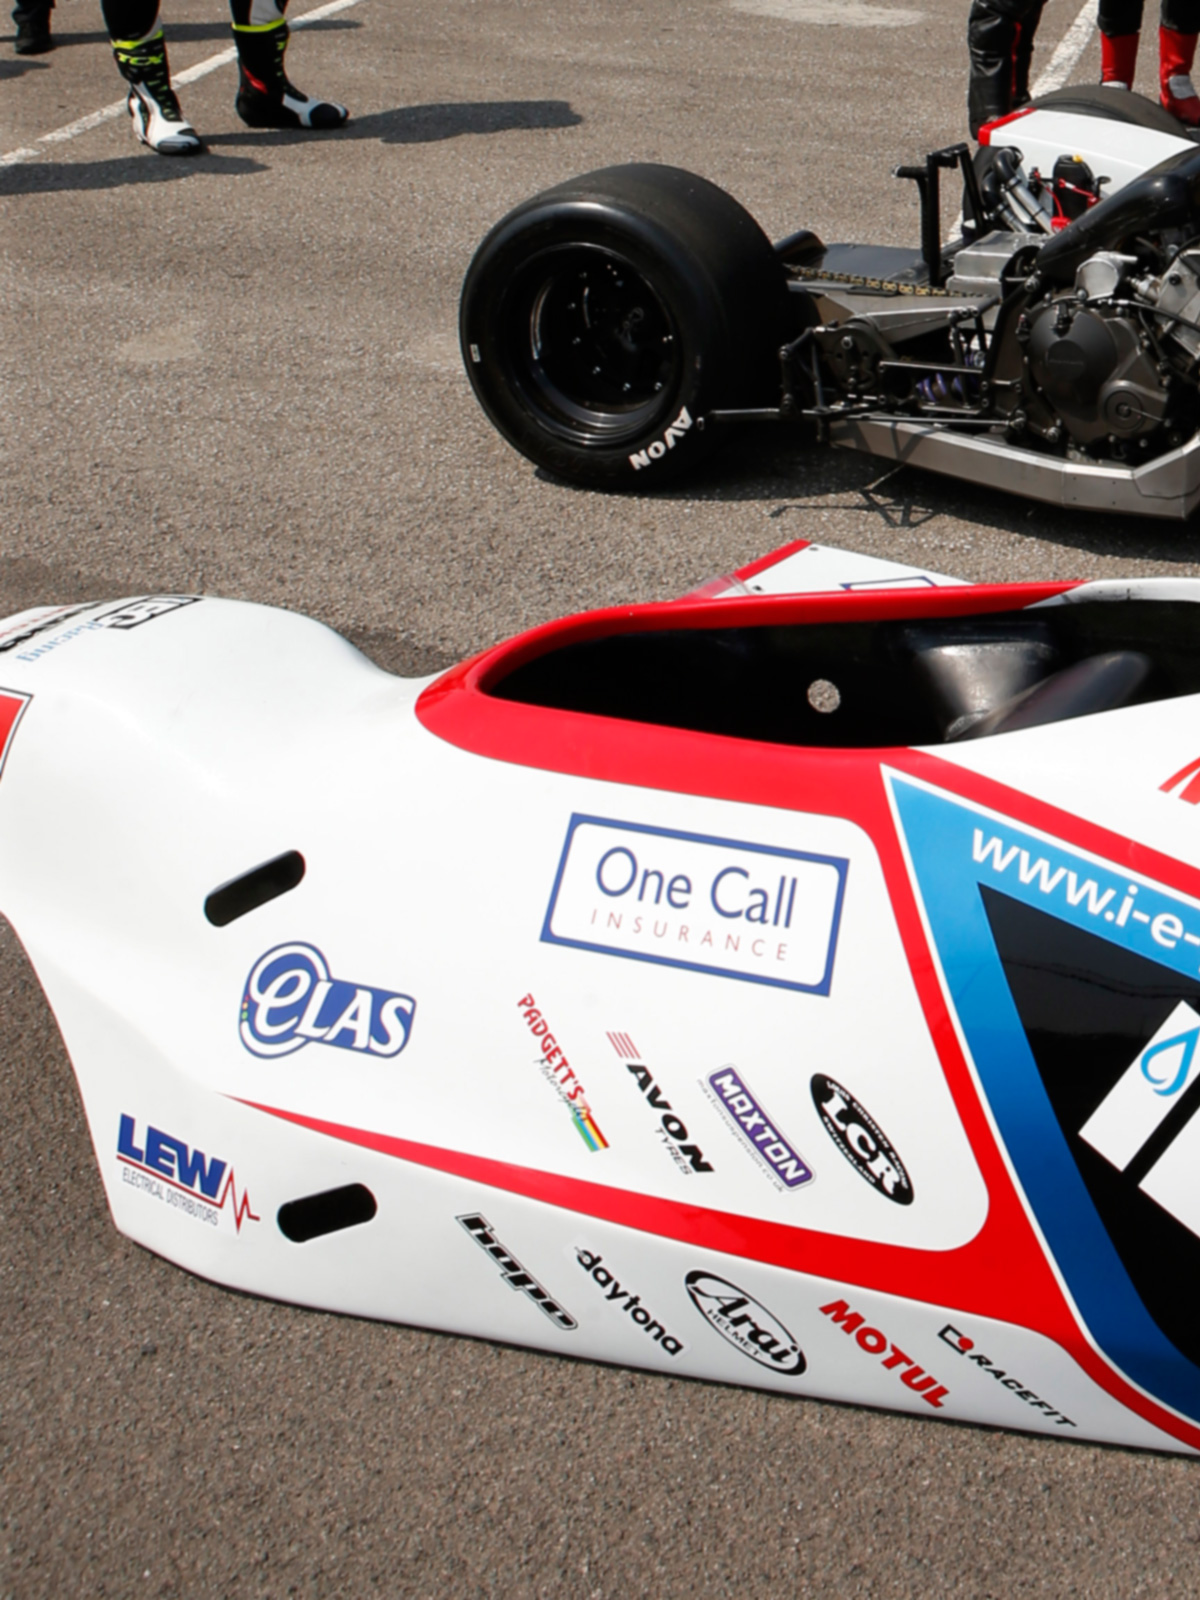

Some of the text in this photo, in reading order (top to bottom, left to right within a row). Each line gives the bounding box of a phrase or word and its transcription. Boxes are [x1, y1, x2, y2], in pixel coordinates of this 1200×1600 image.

[628, 405, 693, 470] AVON
[596, 846, 798, 929] One Call
[590, 908, 789, 962] INSURANCE
[517, 992, 586, 1101] PADGETT'S
[117, 1113, 228, 1200] LEW
[625, 1064, 715, 1173] AVON
[654, 1127, 693, 1175] TYRES
[713, 1073, 806, 1181] MAXTON
[821, 1088, 901, 1195] LCR
[822, 1115, 876, 1184] SWITZERLAND
[122, 1166, 219, 1227] ELECTRICAL DISTRIBUTORS
[575, 1247, 684, 1356] daytona
[690, 1284, 801, 1364] Arai
[706, 1308, 761, 1357] HELMET
[819, 1299, 950, 1409] MOTUL
[968, 1353, 1077, 1428] RACEFIT
